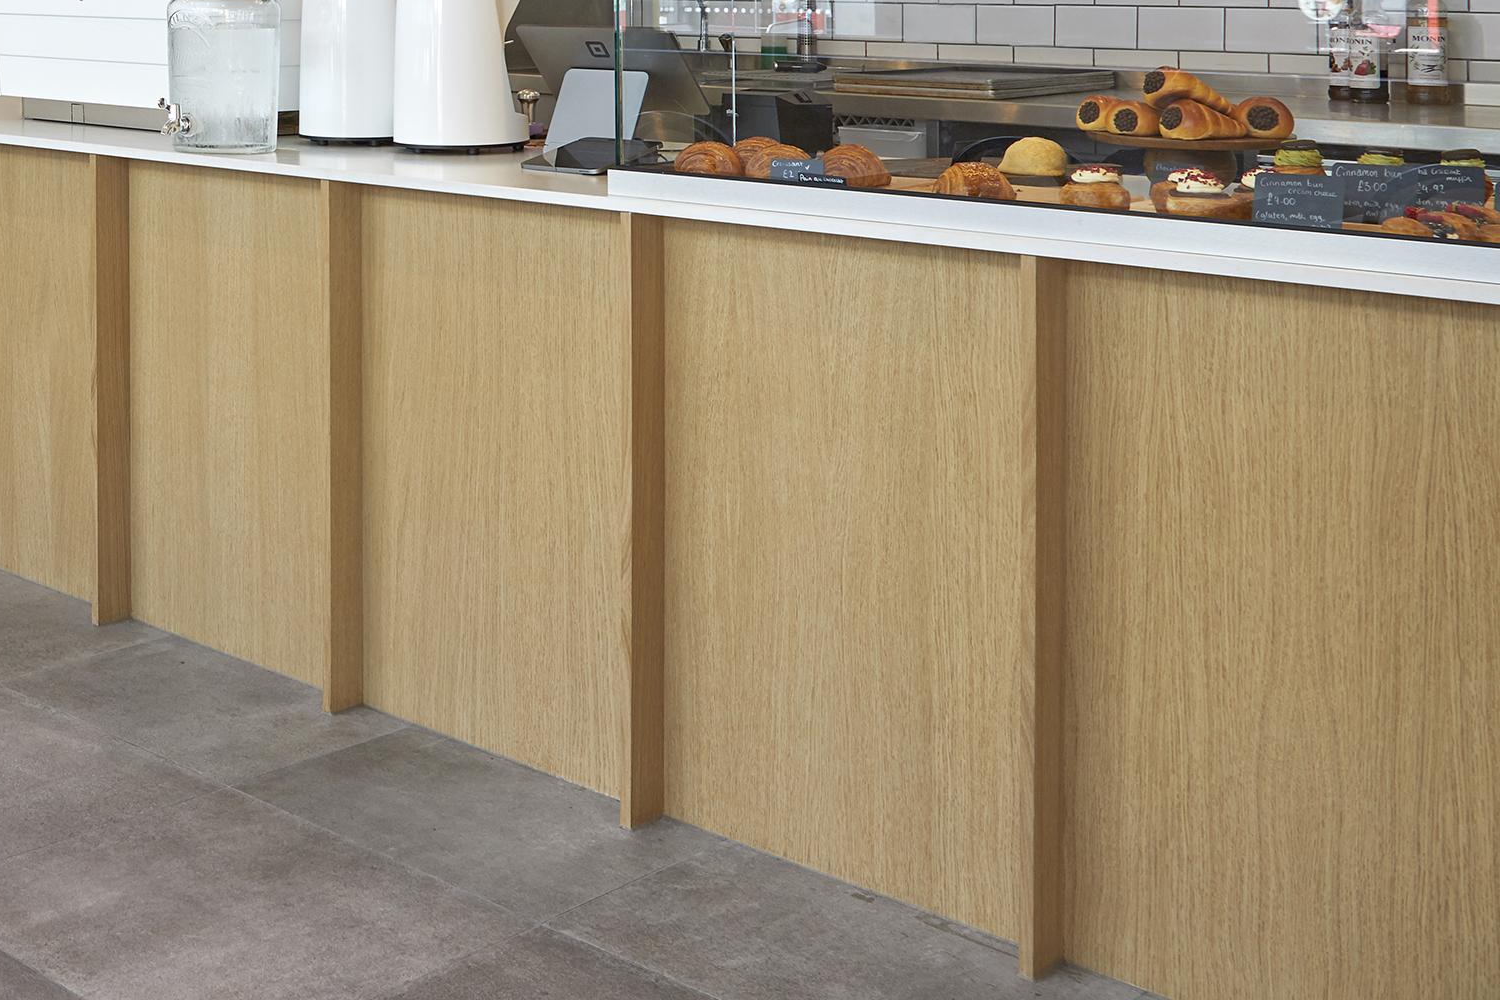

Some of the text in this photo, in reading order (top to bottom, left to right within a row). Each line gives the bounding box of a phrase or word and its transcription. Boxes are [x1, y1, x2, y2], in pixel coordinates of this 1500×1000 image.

[1349, 37, 1373, 45] ONIN
[1412, 34, 1445, 43] MONIN
[1335, 165, 1379, 178] Cinnamon
[1384, 168, 1403, 180] bun
[1260, 176, 1324, 189] Cinnamon bun
